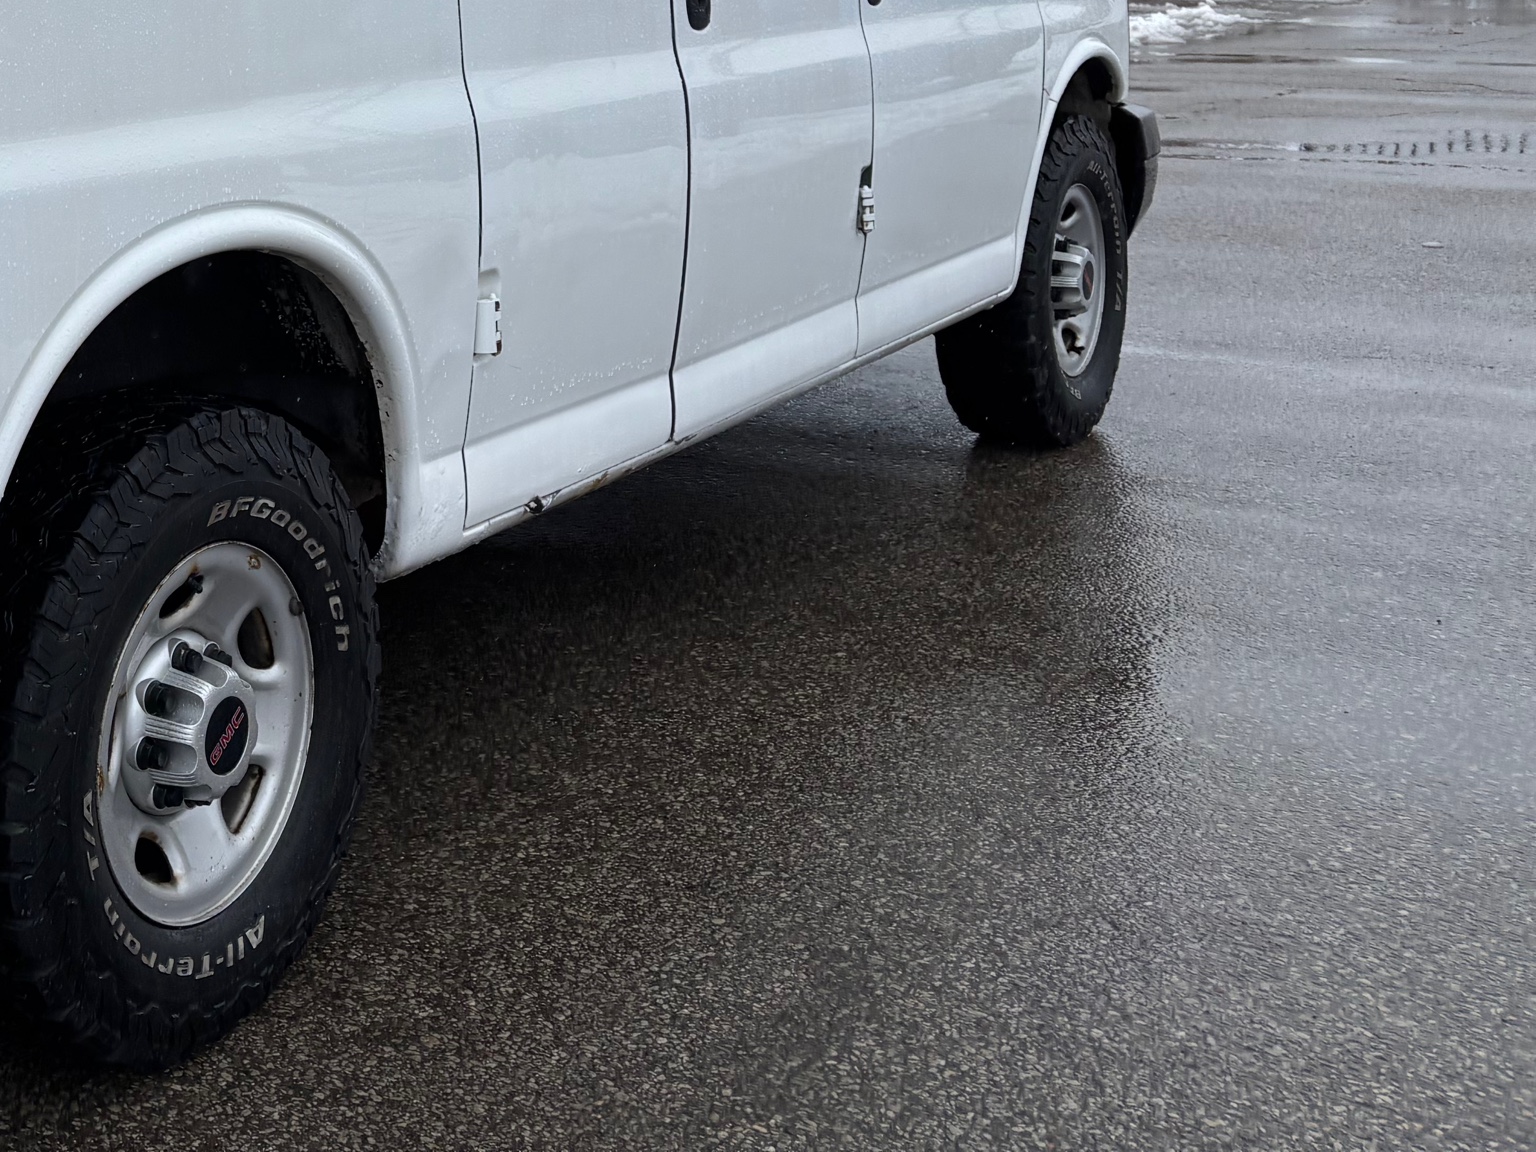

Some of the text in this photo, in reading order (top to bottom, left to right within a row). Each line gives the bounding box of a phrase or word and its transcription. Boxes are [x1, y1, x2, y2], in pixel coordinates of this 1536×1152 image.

[207, 496, 350, 652] BFGoodrich
[209, 705, 245, 766] GMC
[83, 788, 265, 980] All-Terrain T/A
